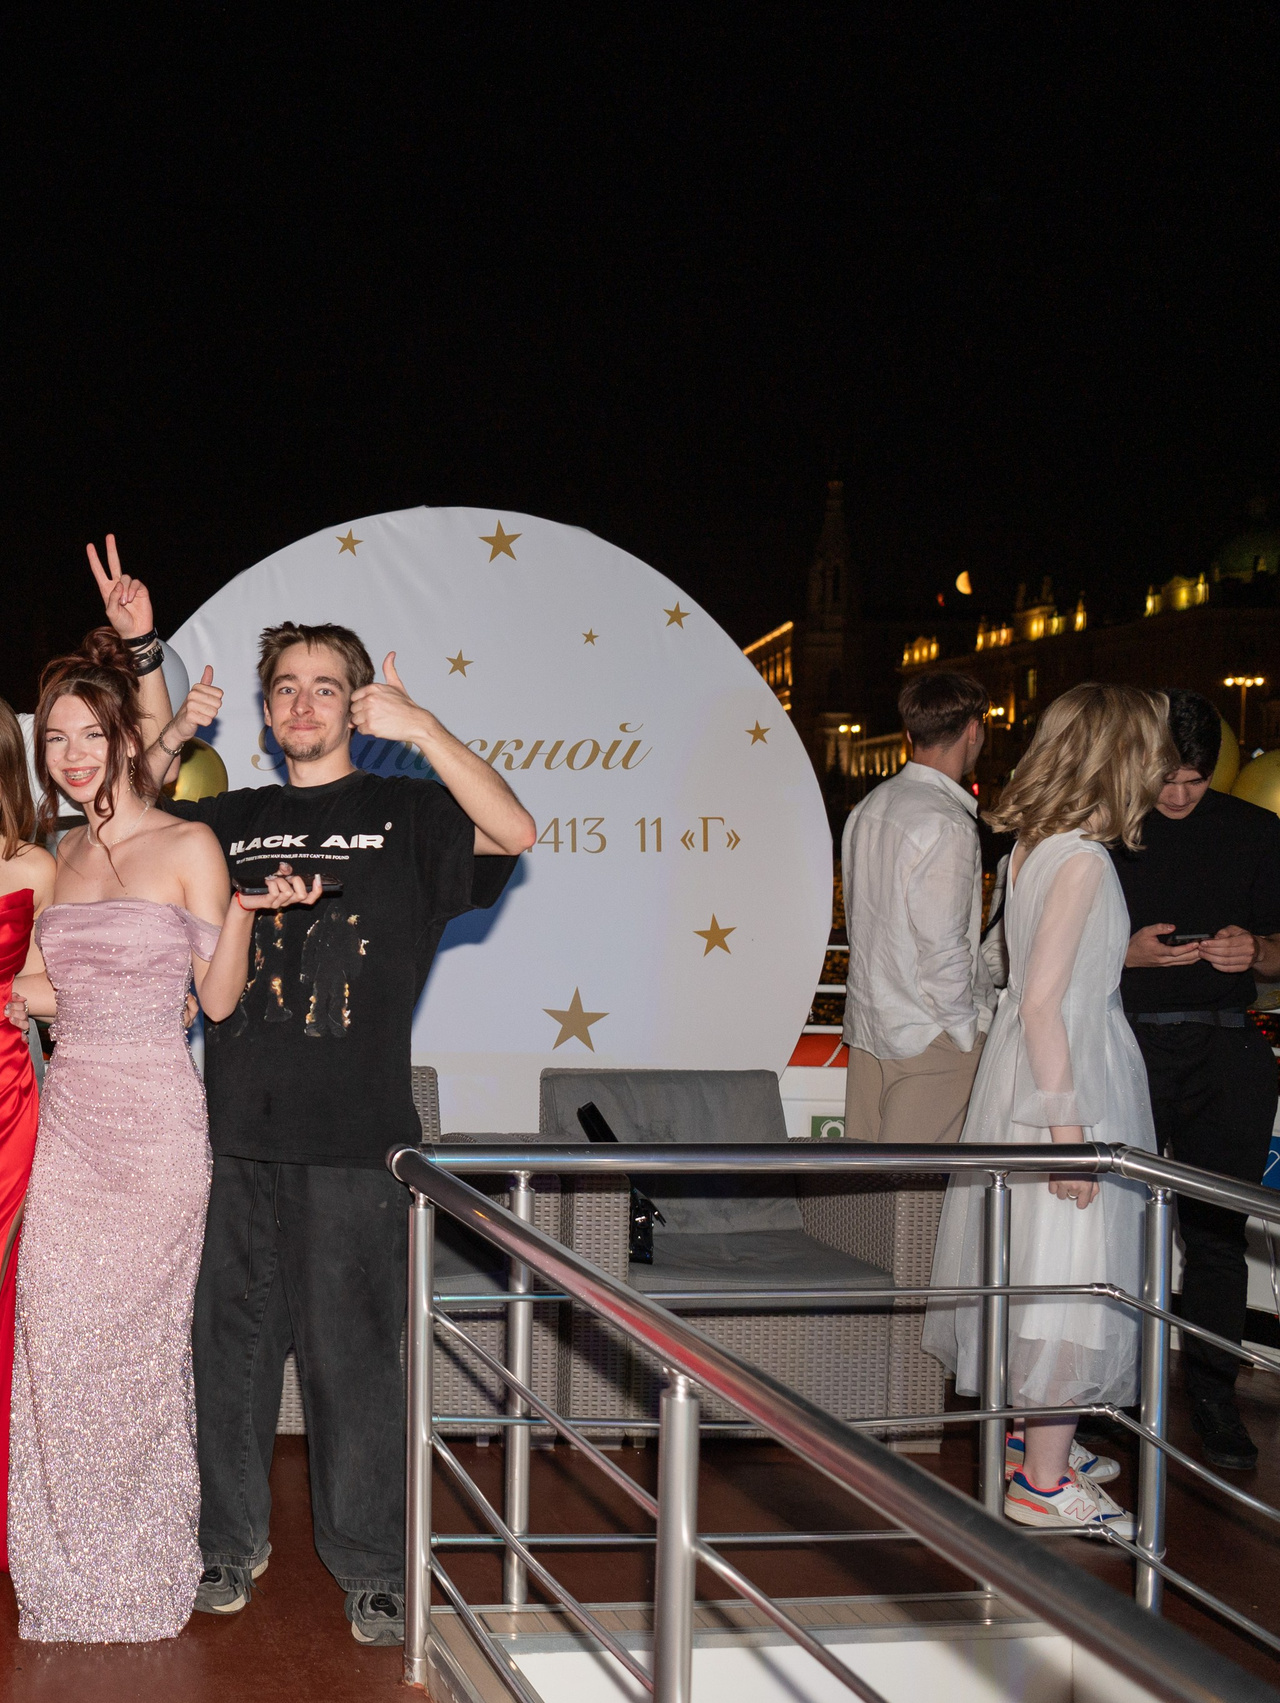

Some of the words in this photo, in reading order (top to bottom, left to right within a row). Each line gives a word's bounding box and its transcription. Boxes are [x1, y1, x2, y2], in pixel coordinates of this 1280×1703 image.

[527, 817, 607, 854] 413
[634, 816, 662, 853] 11
[680, 816, 741, 853] «Г»
